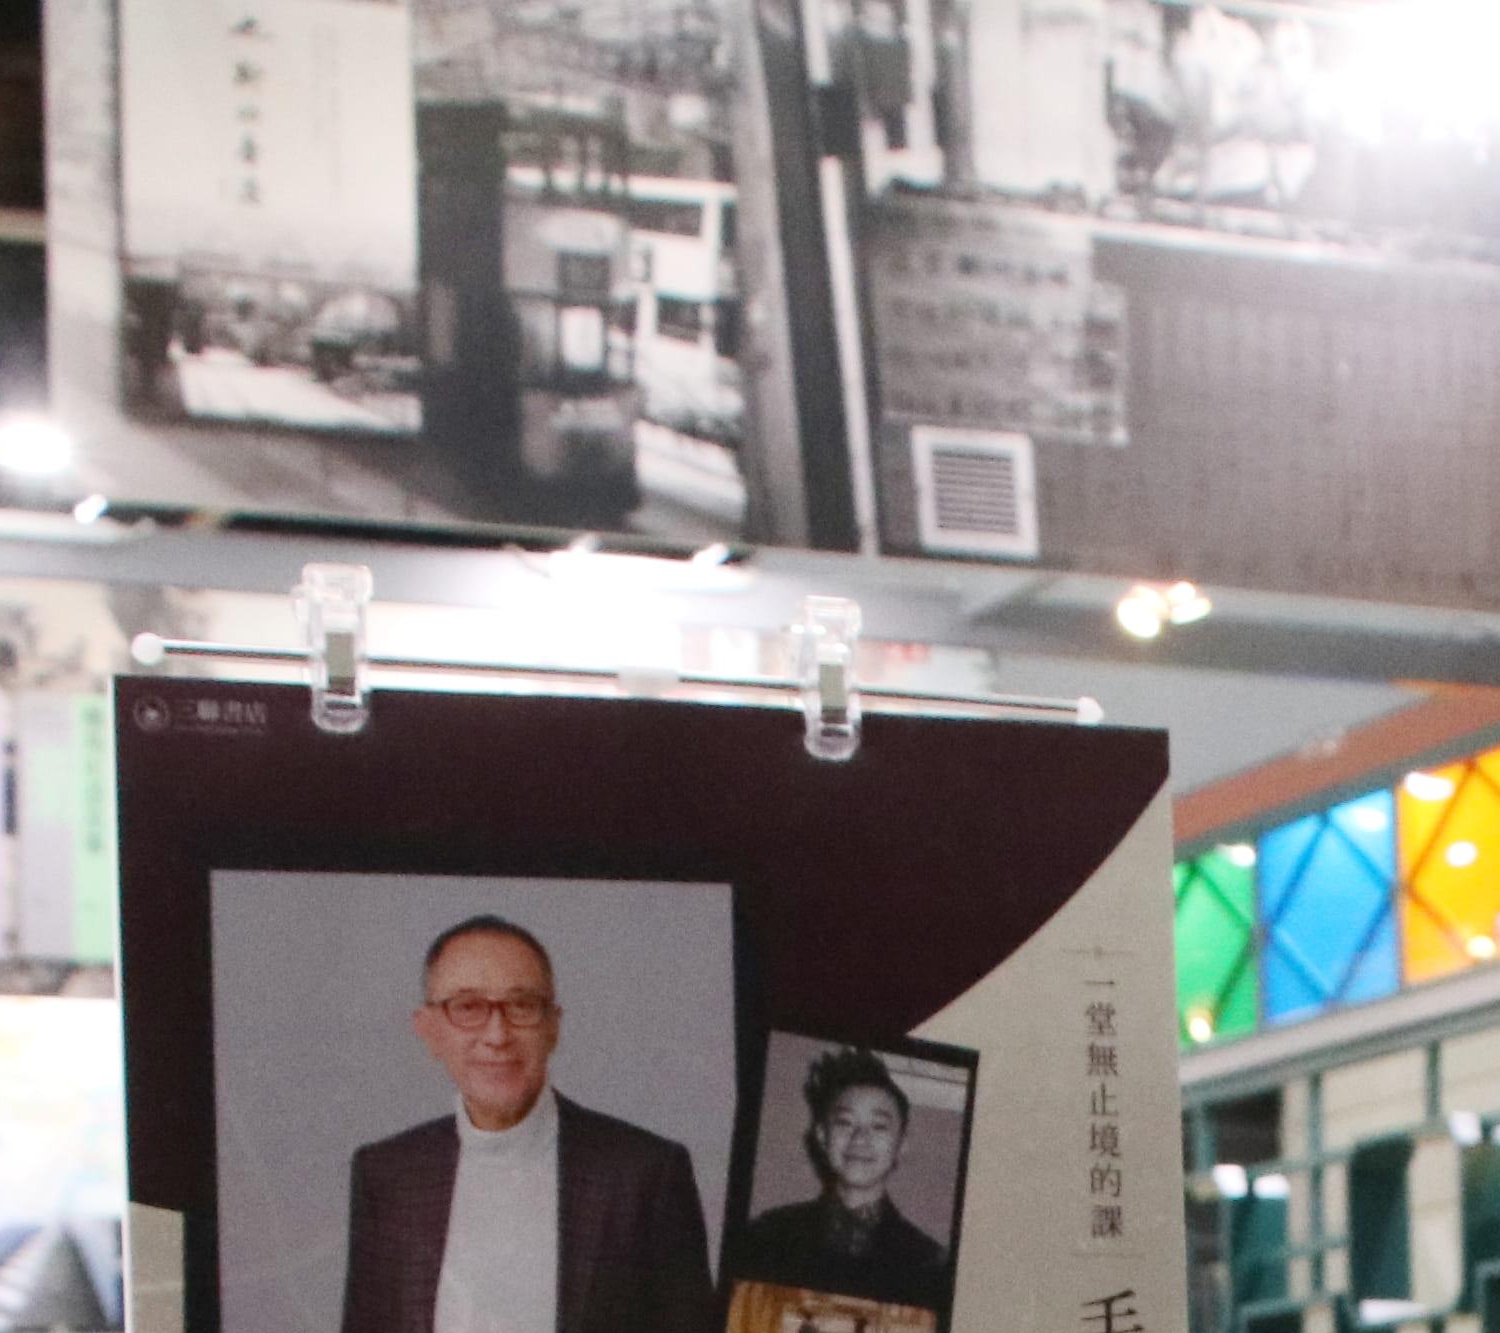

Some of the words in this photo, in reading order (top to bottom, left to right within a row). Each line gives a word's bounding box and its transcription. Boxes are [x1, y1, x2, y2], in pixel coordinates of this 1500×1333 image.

[1083, 979, 1123, 1240] 一堂無止境的課
